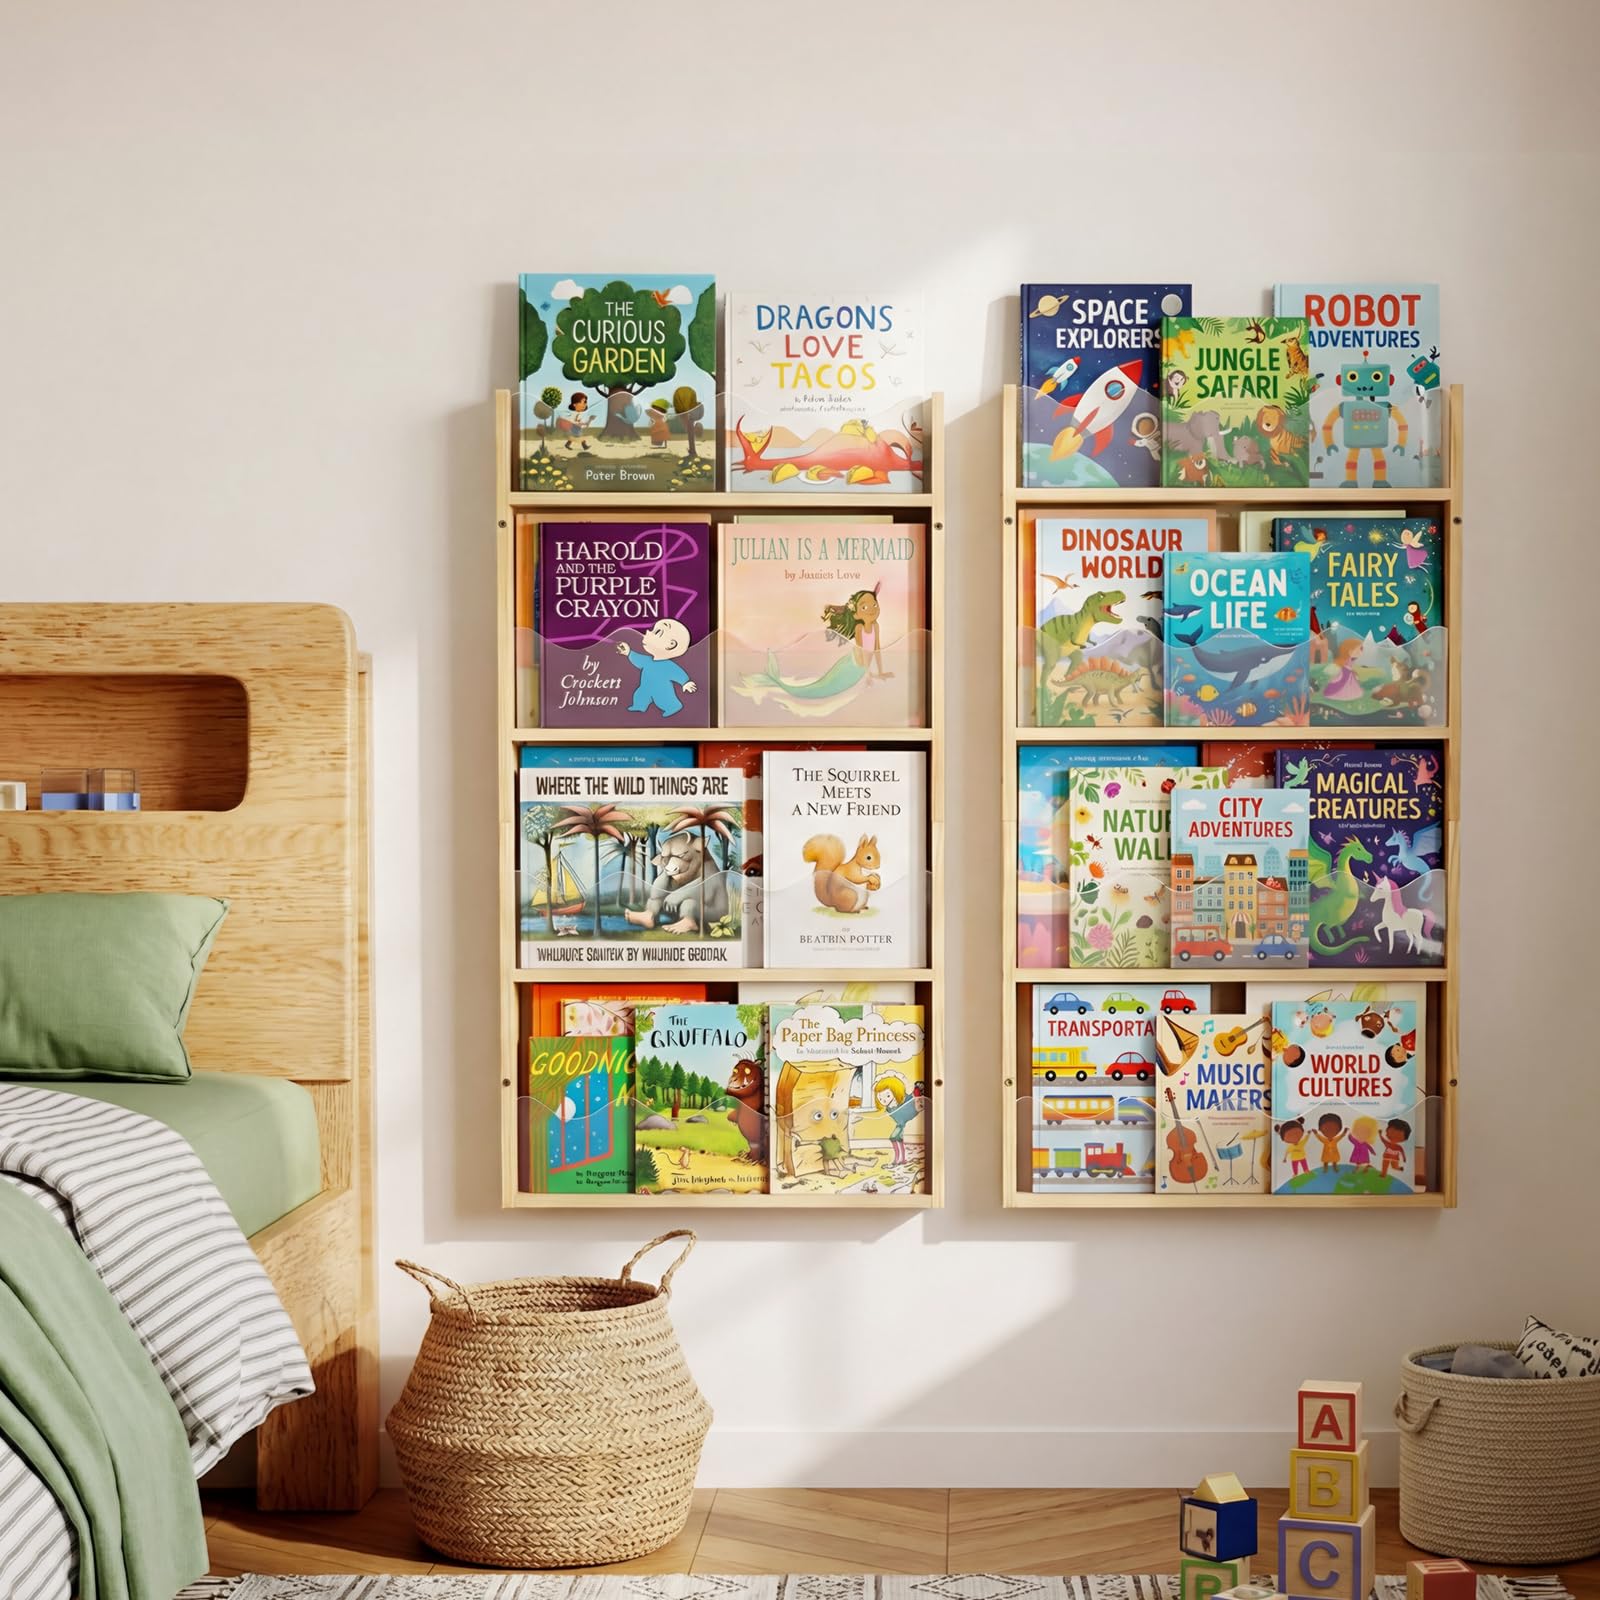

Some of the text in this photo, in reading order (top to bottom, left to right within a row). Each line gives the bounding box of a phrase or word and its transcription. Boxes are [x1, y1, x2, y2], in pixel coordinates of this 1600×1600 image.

[605, 302, 634, 317] THE
[757, 305, 893, 332] DRAGONS
[1072, 299, 1149, 326] SPACE
[1305, 294, 1422, 327] ROBOT
[572, 320, 666, 344] CURIOUS
[1056, 328, 1161, 350] EXPLORERS
[1309, 330, 1420, 349] ADVENTURES
[785, 335, 864, 359] LOVE
[572, 348, 666, 374] GARDEN
[1194, 348, 1281, 372] JUNGLE
[770, 363, 877, 390] TACOS
[1196, 375, 1279, 399] SAFARI
[555, 541, 663, 561] HAROLD
[731, 537, 915, 565] JULIAN IS A MERMAID
[1061, 528, 1183, 552] DINOSAUR
[555, 563, 616, 574] AND THE
[837, 569, 861, 580] Love
[1081, 556, 1163, 579] WORLD
[1327, 552, 1399, 578] FAIRY
[555, 576, 657, 596] PURPLE
[1189, 568, 1287, 597] OCEAN
[1326, 582, 1400, 608] TALES
[555, 598, 660, 618] CRAYON
[1210, 601, 1268, 630] LIFE
[582, 655, 600, 676] by
[536, 776, 729, 796] WHERE THE WILD THINGS ARE
[792, 767, 900, 784] THE SQUIRREL
[1316, 772, 1408, 795] MAGICAL
[822, 785, 872, 799] MEETS
[791, 802, 902, 816] A NEW FRIEND
[1218, 797, 1264, 818] CITY
[1188, 821, 1294, 838] ADVENTURES
[1114, 837, 1171, 861] WAL
[849, 935, 893, 944] POTTER
[668, 1015, 689, 1026] THE
[799, 1018, 820, 1030] The
[1047, 1020, 1155, 1037] TRANSPORTA
[650, 1028, 748, 1048] GRUFFALO
[781, 1027, 917, 1046] Paper Bag Princess
[1197, 1063, 1265, 1086] MUSIC
[1310, 1054, 1381, 1074] WORLD
[1298, 1077, 1393, 1097] CULTURES
[1186, 1089, 1272, 1111] MAKERS
[1310, 1404, 1344, 1440] A
[1308, 1464, 1340, 1507] B
[1299, 1540, 1340, 1588] C
